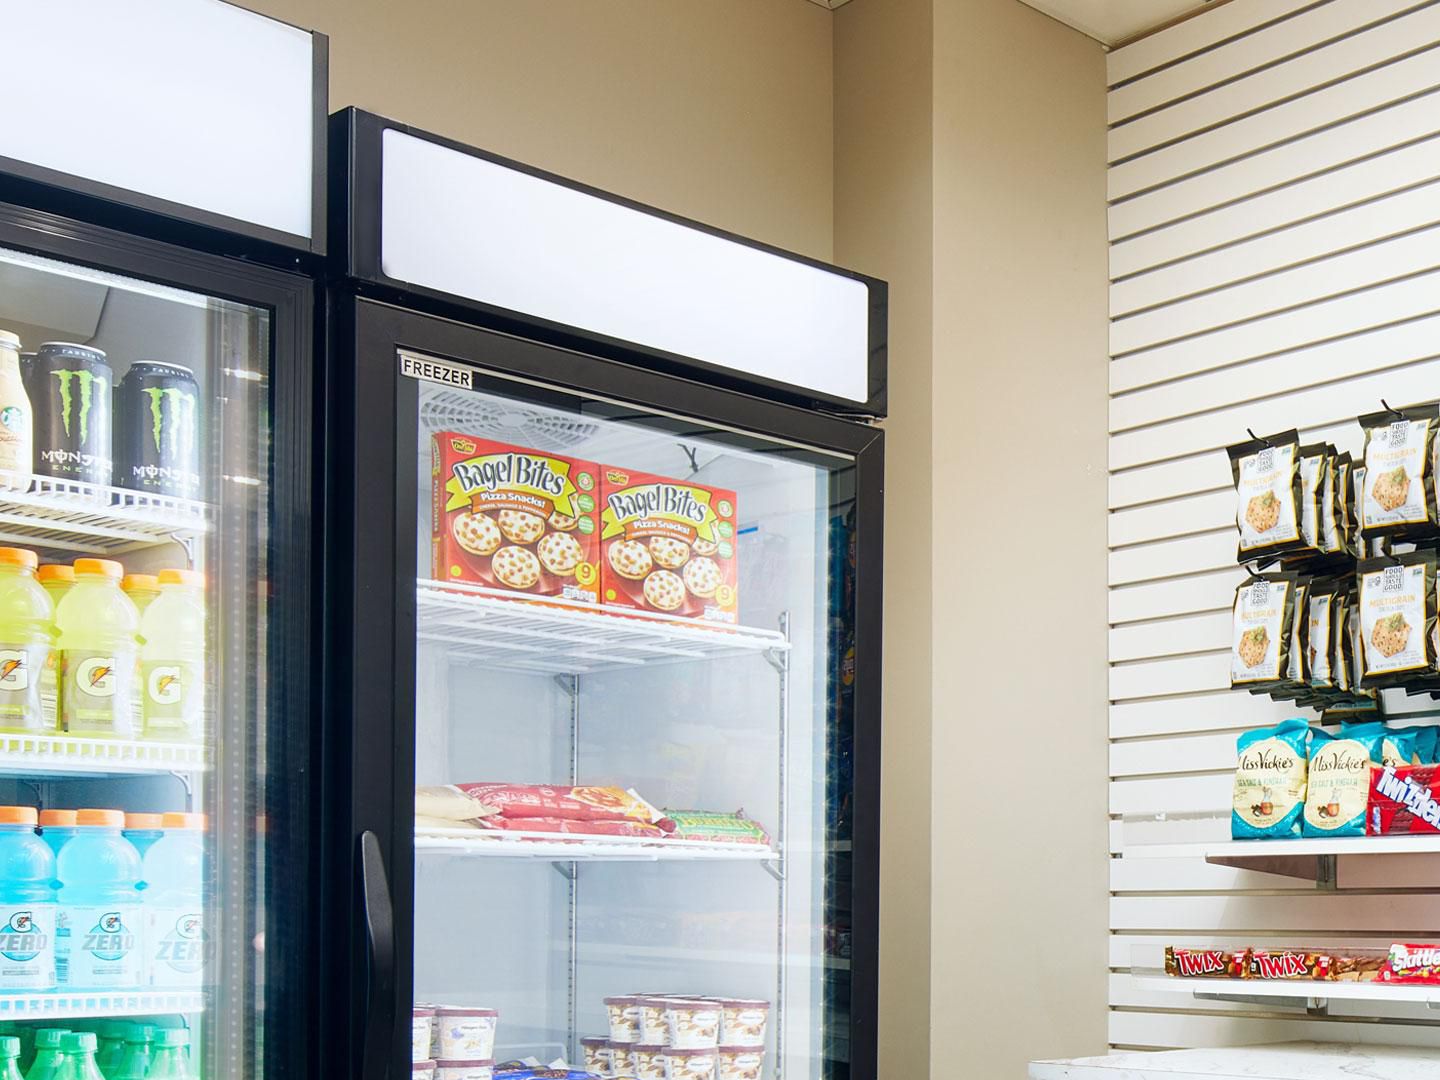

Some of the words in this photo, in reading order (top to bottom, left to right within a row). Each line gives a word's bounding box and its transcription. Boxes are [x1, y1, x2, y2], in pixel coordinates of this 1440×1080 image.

[403, 359, 470, 387] FREEZER
[453, 453, 513, 493] Bagel
[515, 455, 565, 495] Bites
[608, 484, 661, 521] Bagel
[663, 486, 706, 522] Bites
[76, 657, 116, 697] G
[149, 666, 182, 705] G
[1257, 748, 1294, 774] Vickie's
[1333, 750, 1367, 774] Vickie's
[82, 934, 134, 951] ZERO
